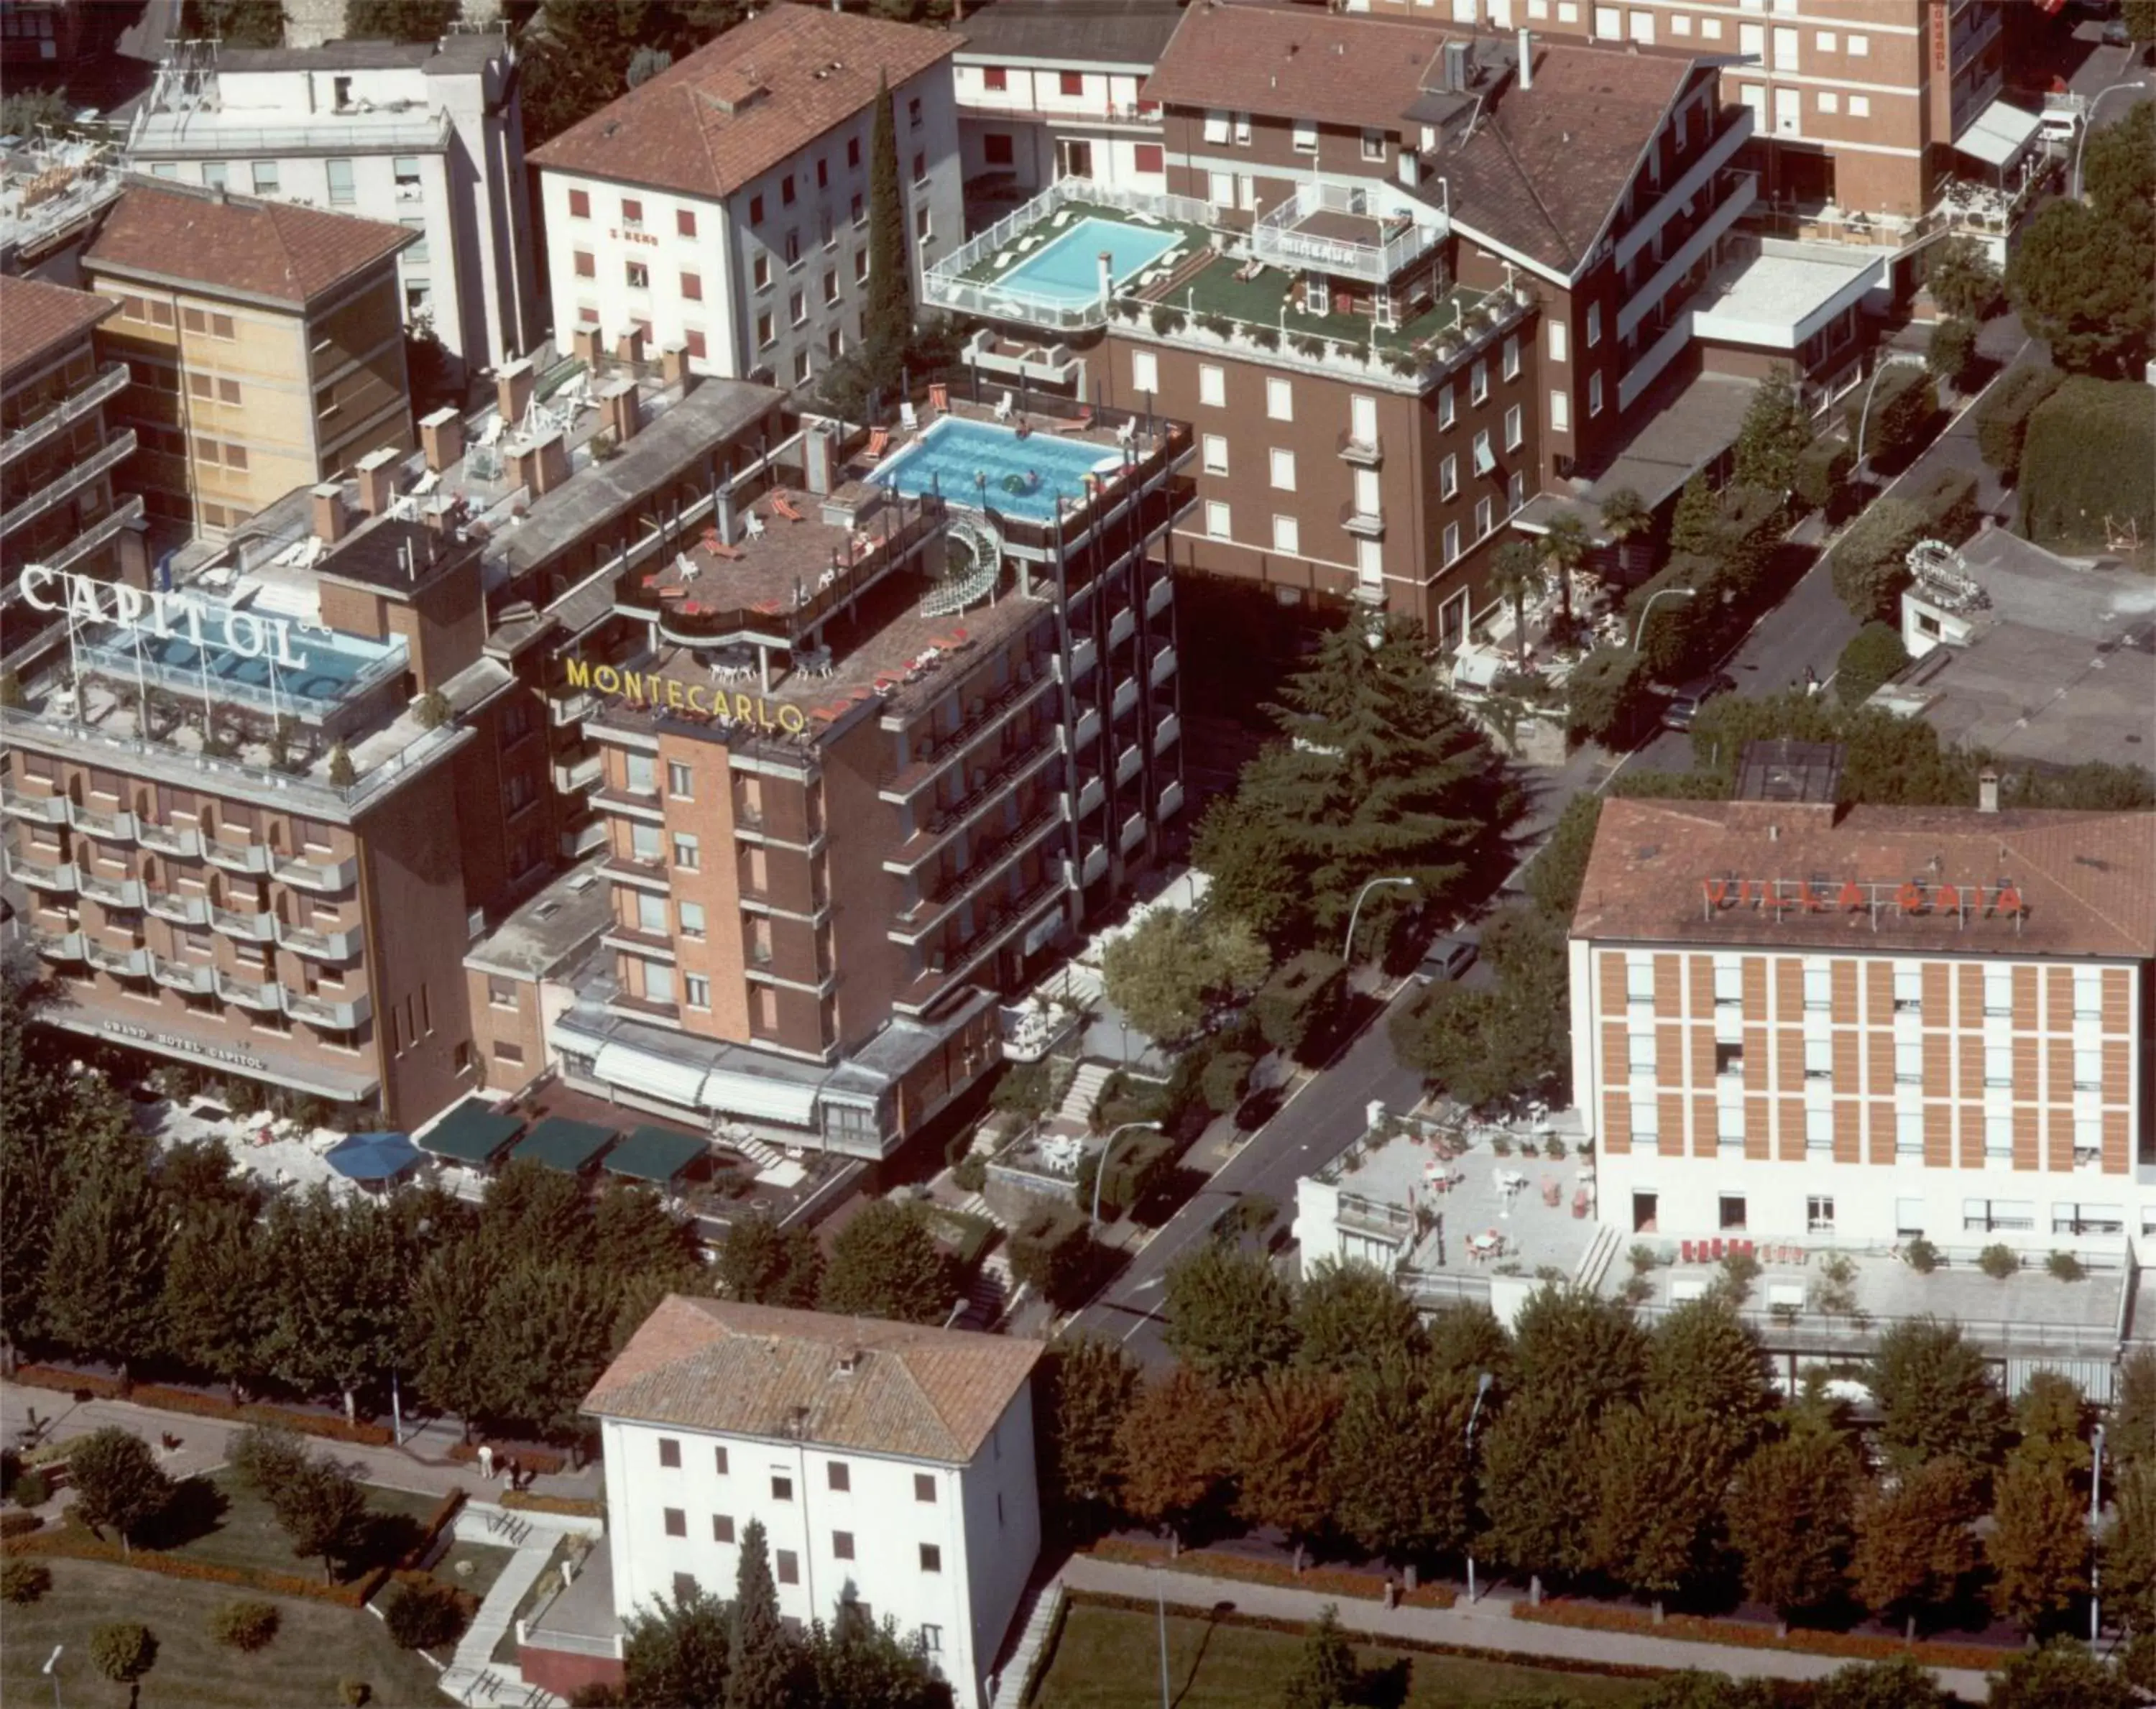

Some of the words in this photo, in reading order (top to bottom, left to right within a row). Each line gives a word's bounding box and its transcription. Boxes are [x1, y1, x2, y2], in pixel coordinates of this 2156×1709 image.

[19, 564, 307, 668] CAPITOL
[566, 657, 803, 732] MONTECARLO
[1703, 875, 1863, 907] VILLA
[1895, 881, 2022, 912] GAIA
[103, 1021, 147, 1039] GRAND
[159, 1033, 201, 1054] HOTEL
[209, 1047, 264, 1070] CAPITOL
